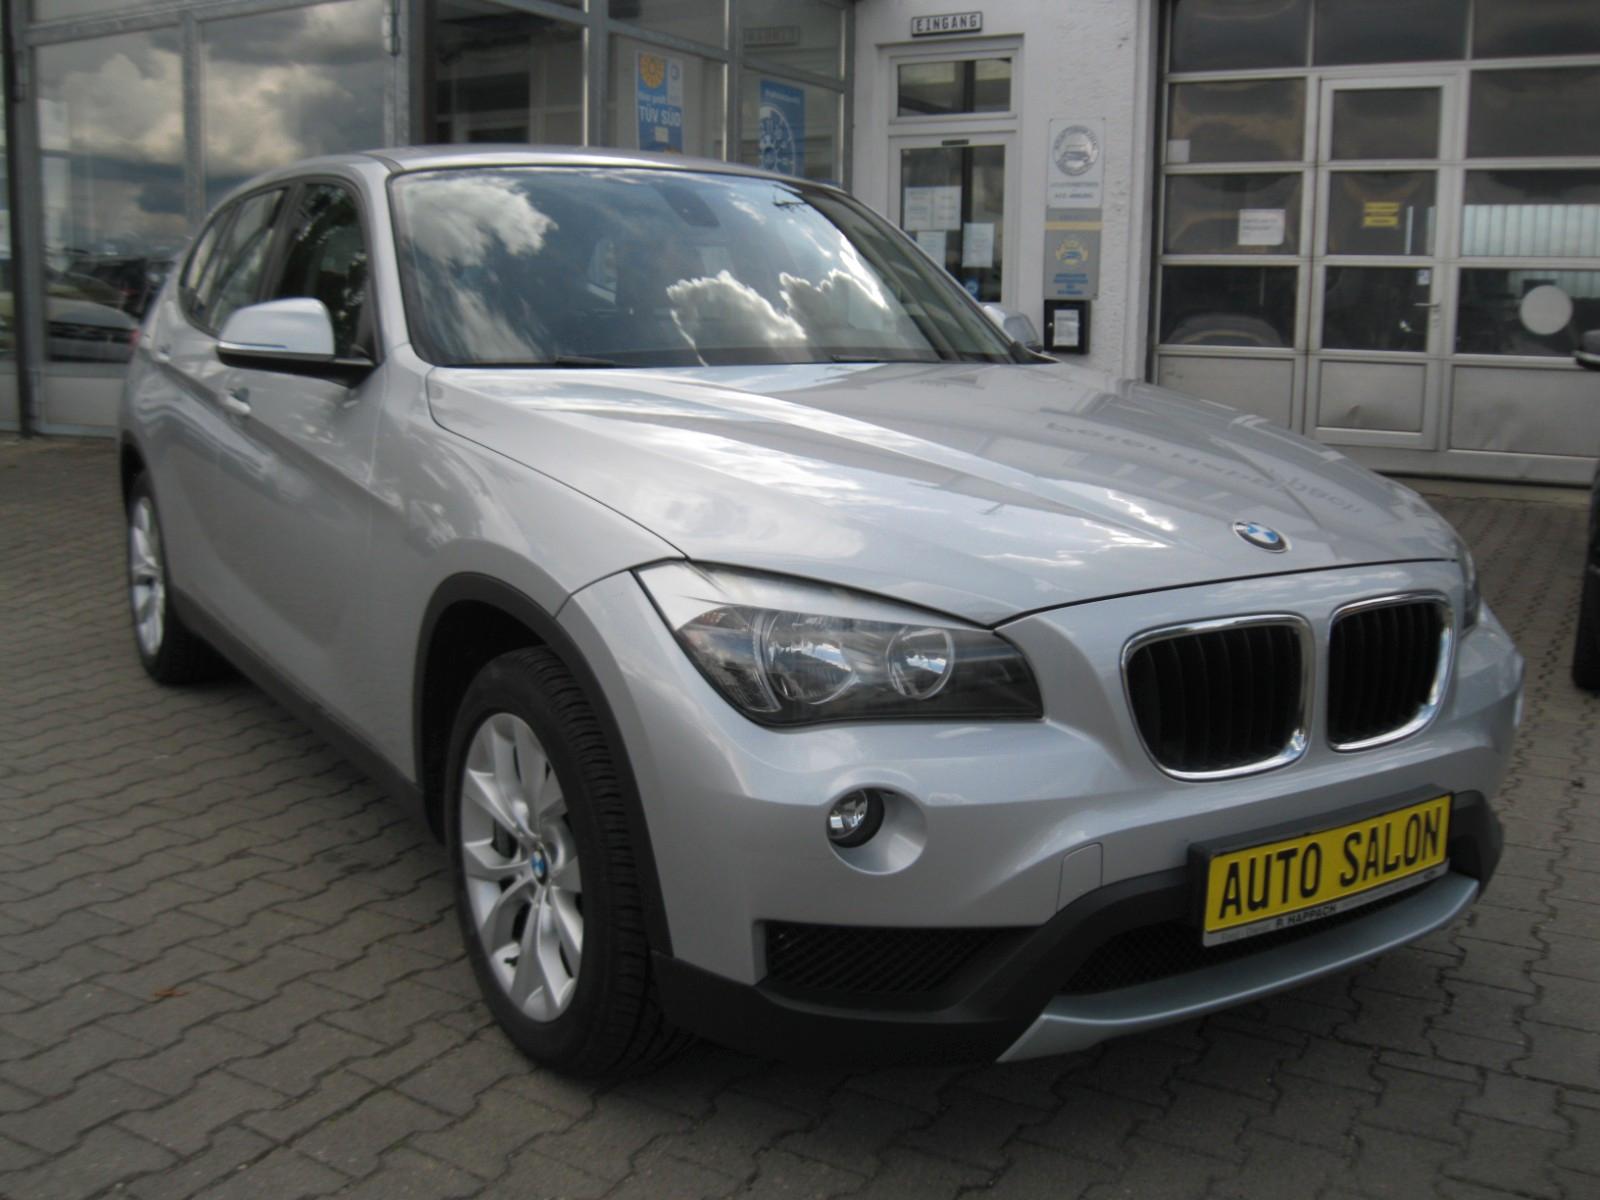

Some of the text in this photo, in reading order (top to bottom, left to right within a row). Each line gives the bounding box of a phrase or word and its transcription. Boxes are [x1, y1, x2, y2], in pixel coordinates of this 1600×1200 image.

[916, 14, 977, 33] EINGANG
[639, 103, 660, 124] TÜV
[1218, 806, 1443, 920] AUTO SALON
